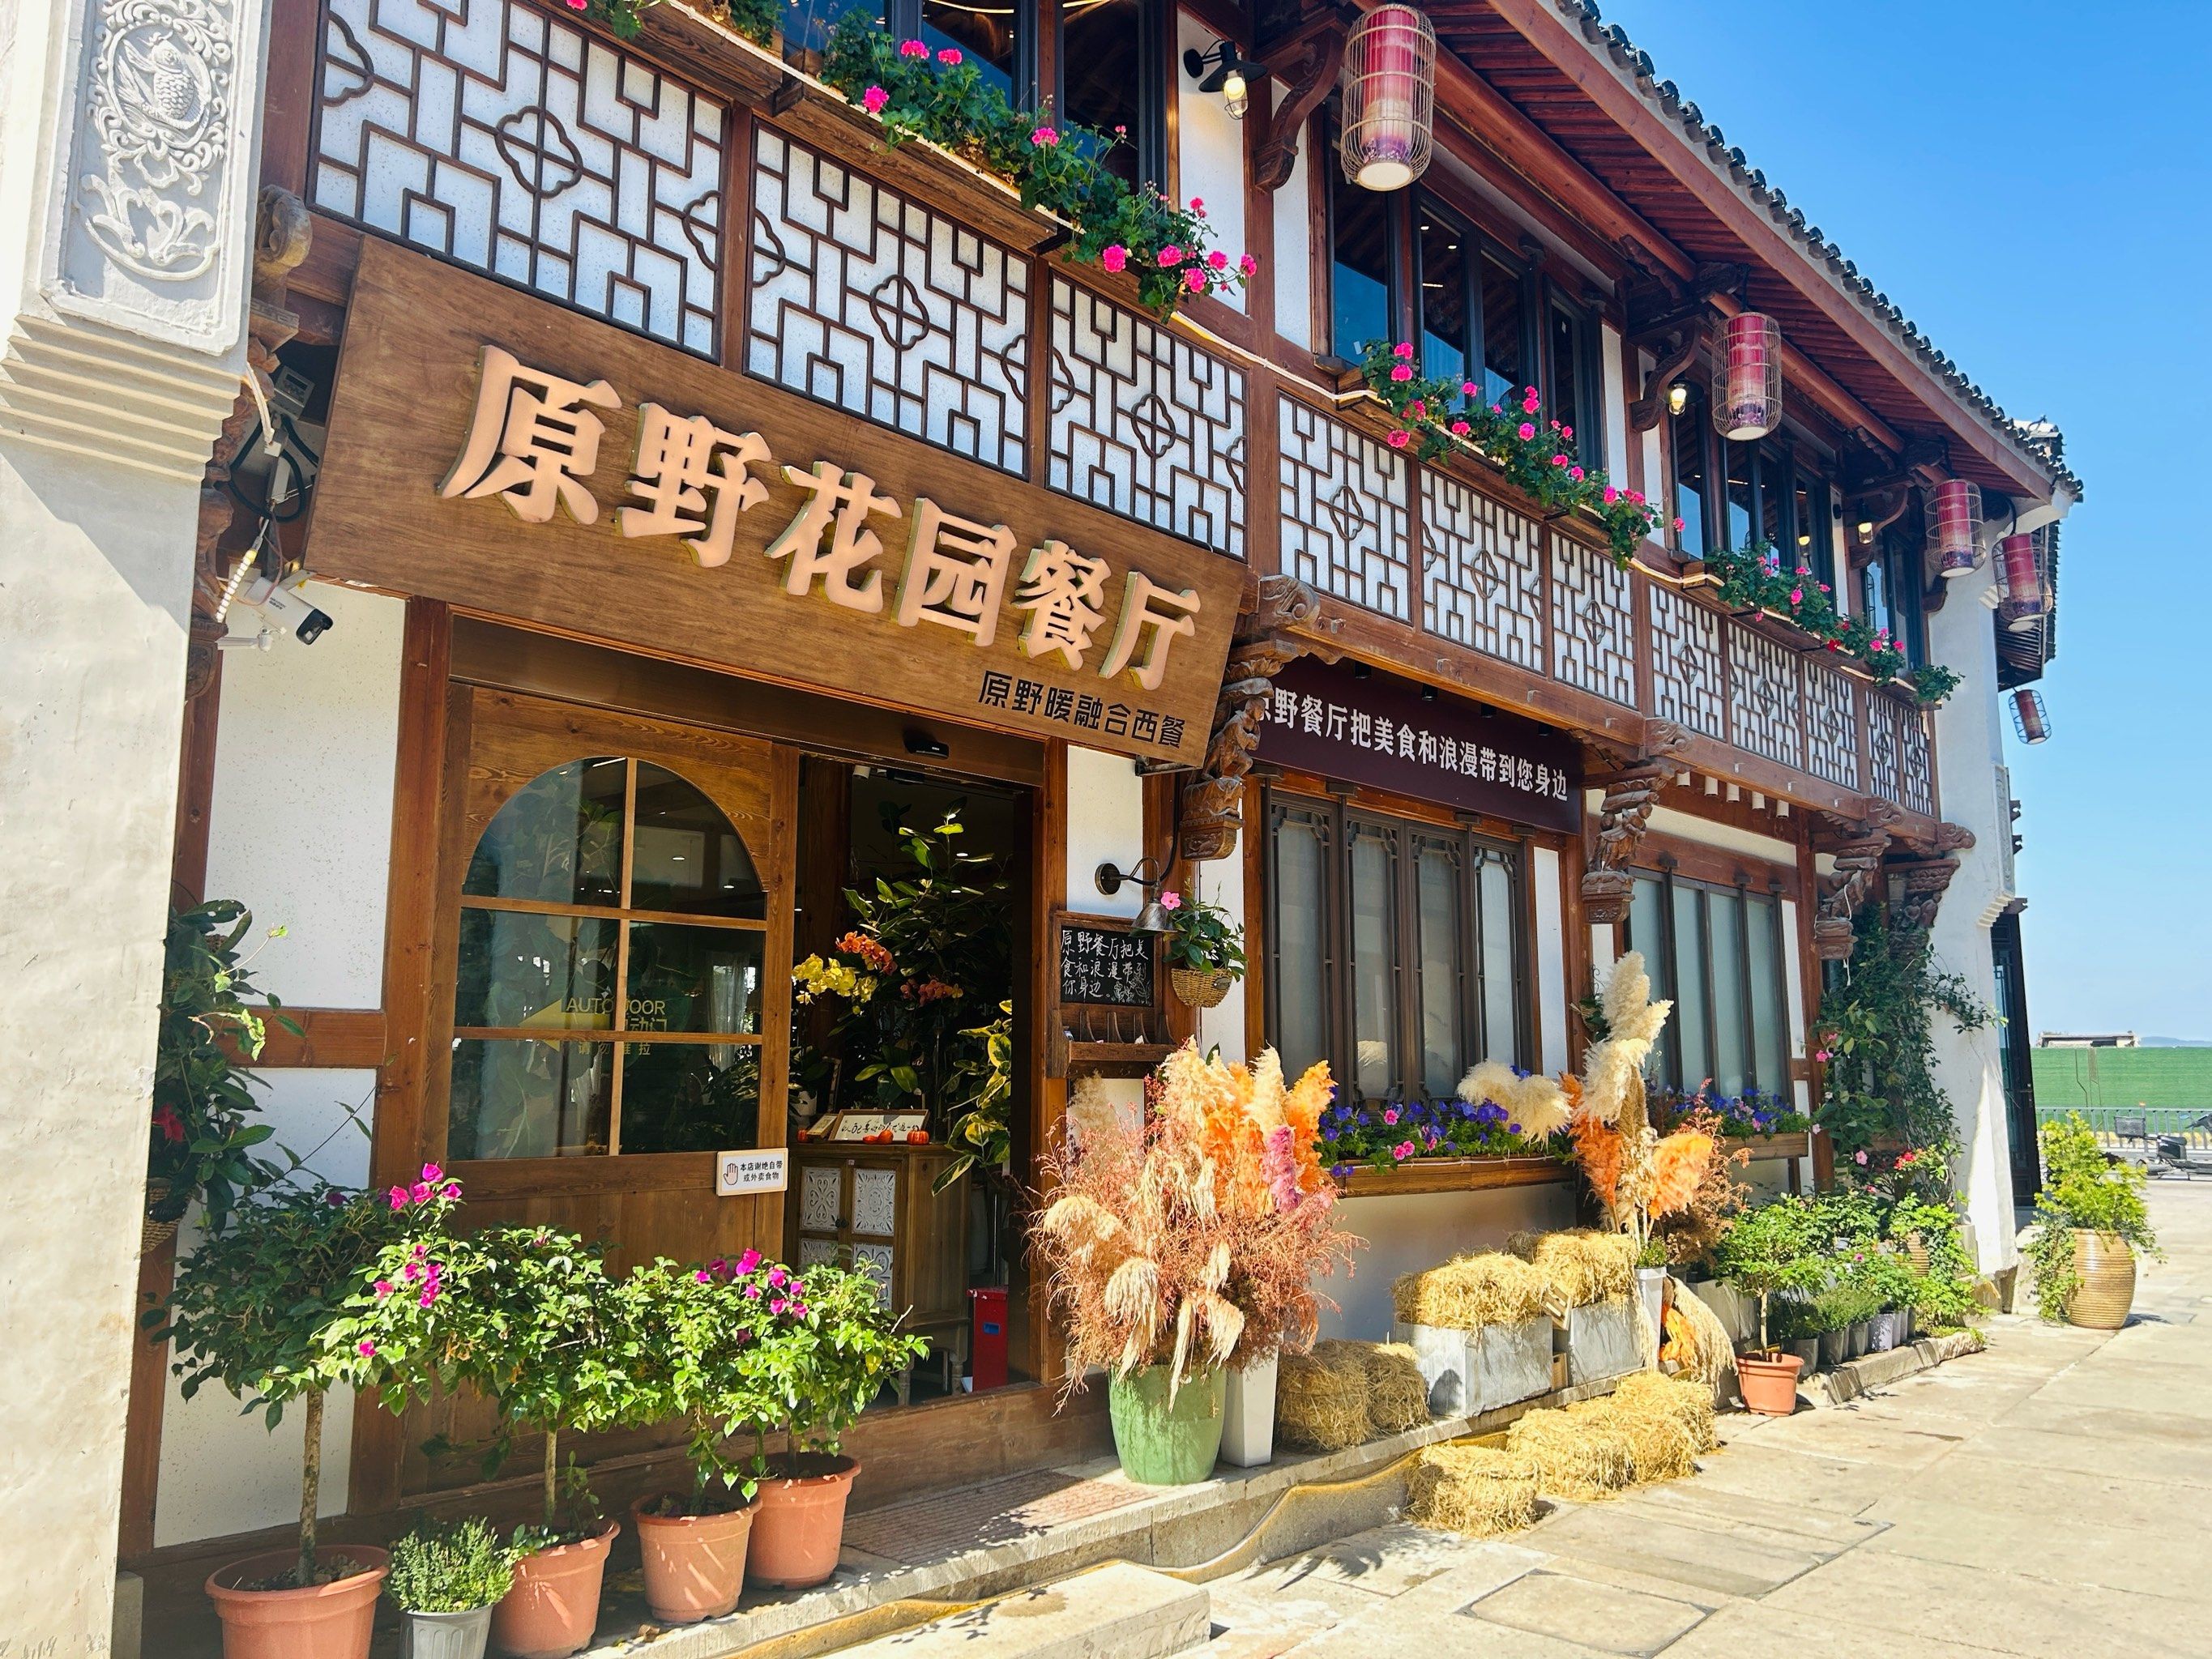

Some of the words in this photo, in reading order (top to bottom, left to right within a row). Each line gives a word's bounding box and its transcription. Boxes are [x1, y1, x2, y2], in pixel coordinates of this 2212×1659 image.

[438, 344, 1202, 691] 原野花园餐厅
[978, 670, 1185, 748] 原野暖融合西餐
[566, 997, 614, 1014] AUTO
[626, 1016, 668, 1031] 动门
[741, 1161, 783, 1171] 本店谢绝自带
[743, 1171, 779, 1182] 或外卖食物
